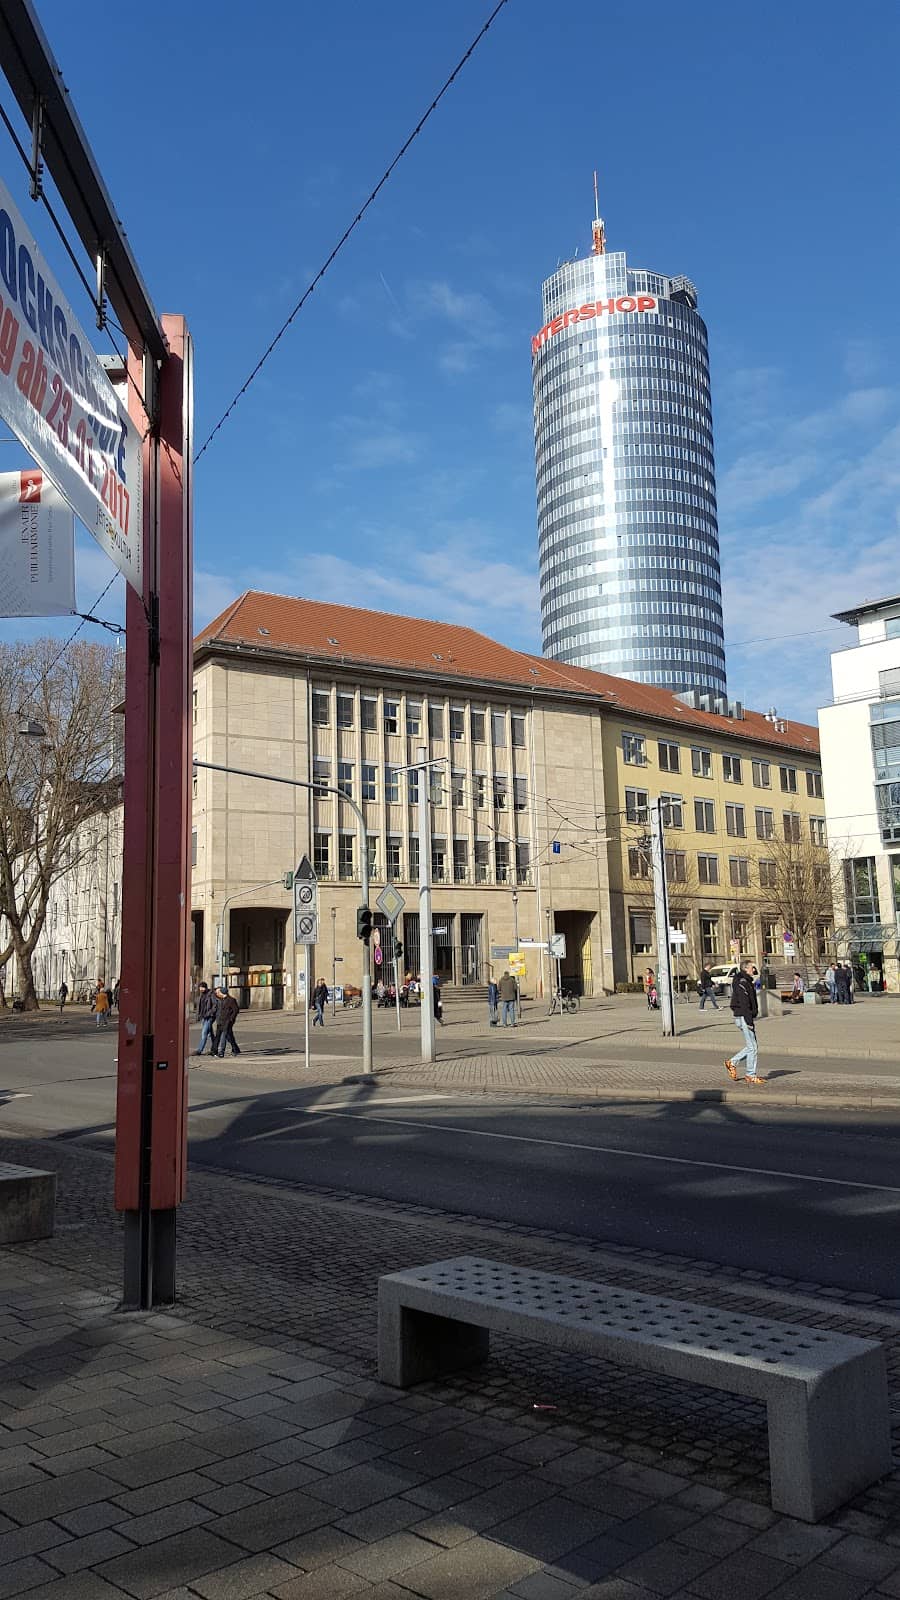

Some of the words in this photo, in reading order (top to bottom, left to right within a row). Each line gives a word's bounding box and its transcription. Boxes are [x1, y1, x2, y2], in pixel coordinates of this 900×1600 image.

[531, 296, 656, 354] NTERSHOP
[17, 340, 48, 415] ab
[21, 505, 30, 544] JENAER
[30, 504, 39, 584] PHILHARMONIE
